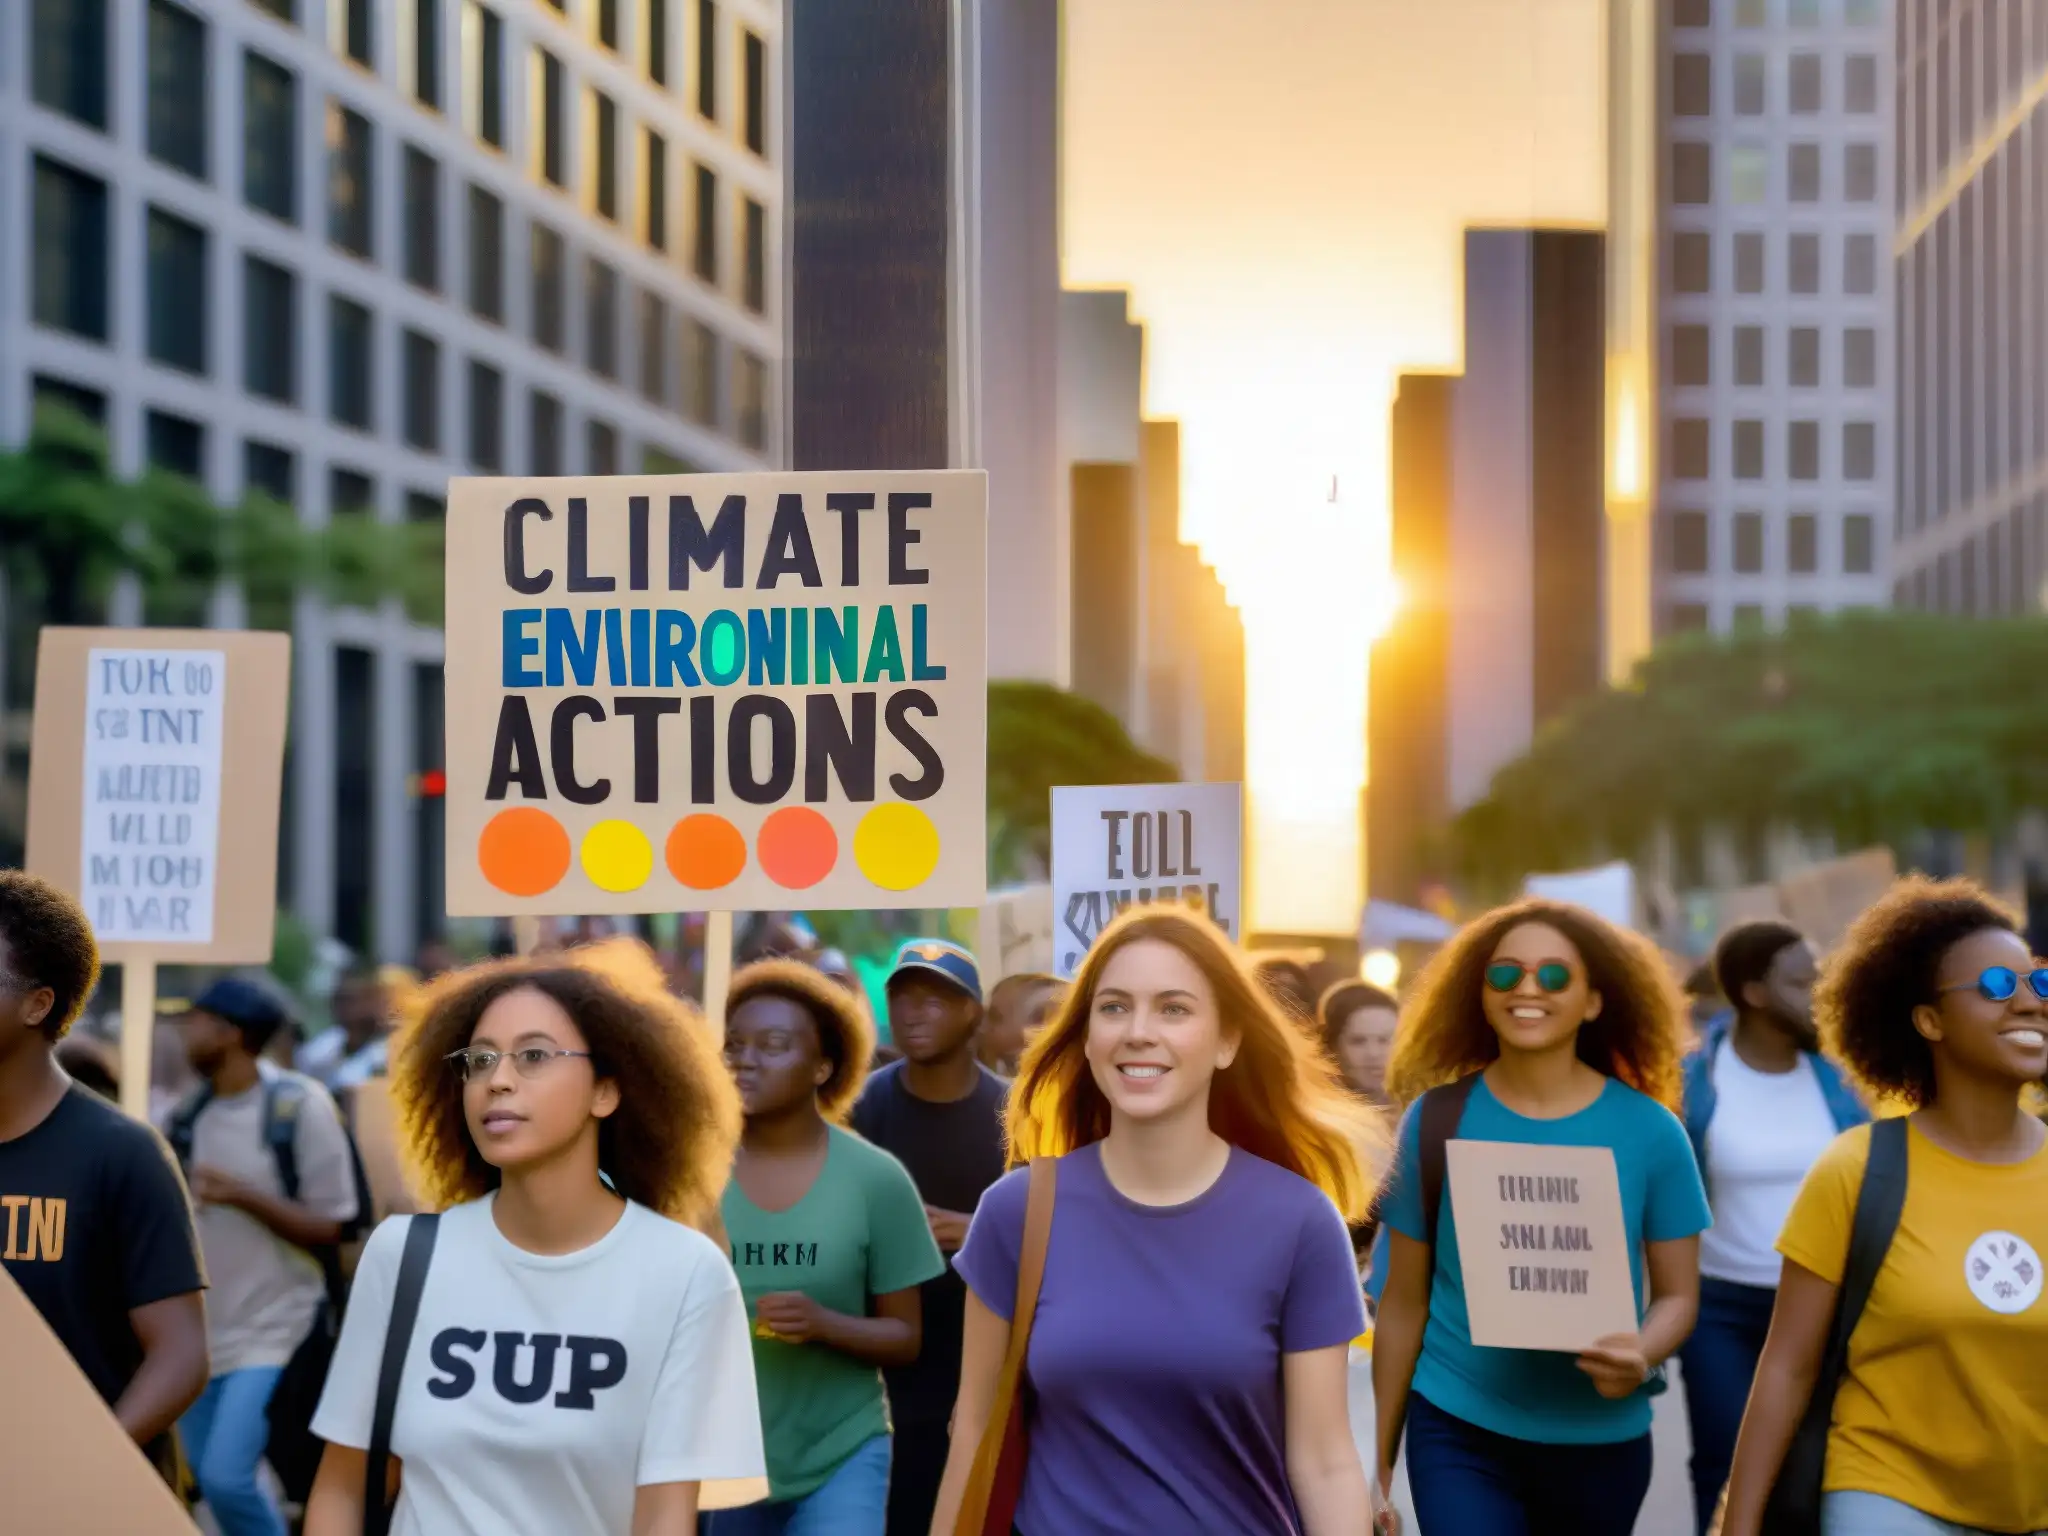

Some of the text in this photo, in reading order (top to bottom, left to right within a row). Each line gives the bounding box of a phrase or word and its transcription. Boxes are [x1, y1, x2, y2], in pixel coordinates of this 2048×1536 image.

[503, 492, 932, 595] CLIMATE
[484, 688, 945, 805] ACTIONS
[427, 1326, 628, 1411] SUP
